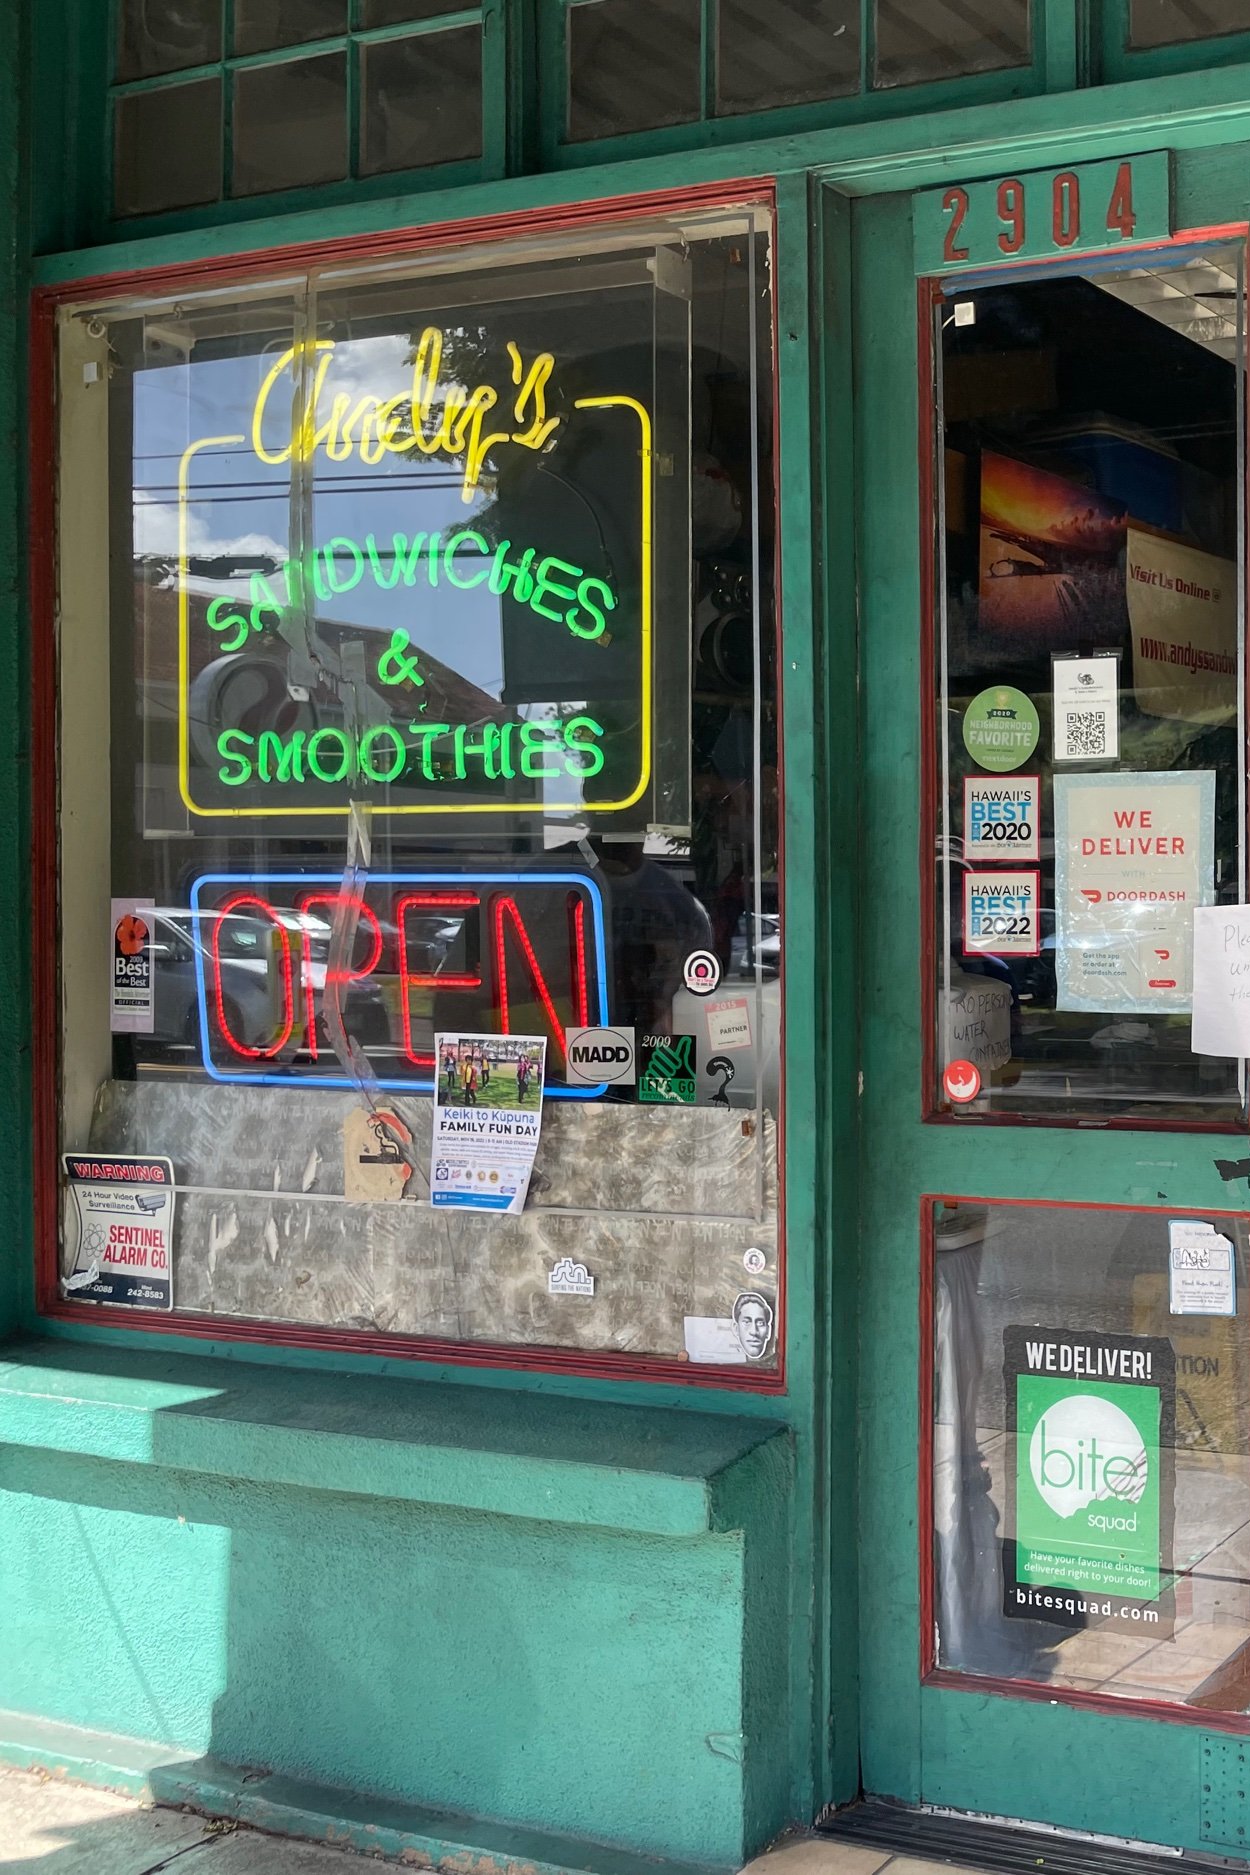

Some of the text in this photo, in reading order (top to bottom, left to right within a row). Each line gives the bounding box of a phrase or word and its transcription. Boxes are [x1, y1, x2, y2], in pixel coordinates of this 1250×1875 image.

[942, 162, 1136, 264] 2904
[252, 327, 561, 503] Andy's
[205, 529, 618, 652] SANDWICHES
[1129, 563, 1210, 601] Visit Us Online
[377, 628, 424, 687] &
[970, 720, 1033, 731] NEIGHBORHOOD
[969, 731, 1032, 747] FAVORITE
[217, 716, 605, 787] SMOOTHIES
[971, 791, 1032, 802] HAWAII'S
[971, 802, 1032, 822] BEST
[1114, 811, 1152, 829] WE
[982, 822, 1032, 841] 2020
[1081, 837, 1185, 856] DELIVER
[1122, 870, 1146, 878] WITH
[971, 885, 1031, 896] HAWAII'S
[1107, 891, 1185, 903] DOORDASH
[971, 897, 1031, 916] BEST
[982, 917, 1031, 935] 2022
[115, 957, 149, 976] Best
[130, 977, 146, 987] Best
[212, 890, 589, 1064] OPEN
[715, 1001, 737, 1011] 2015
[719, 1025, 748, 1035] PARTNER
[953, 1020, 989, 1041] WATER
[642, 1035, 671, 1048] 2009
[572, 1046, 630, 1063] MADD
[641, 1078, 695, 1094] LET'S GO
[444, 1108, 473, 1120] Keiki
[476, 1110, 488, 1121] to
[440, 1121, 538, 1136] FAMILY FUN DAY
[74, 1163, 165, 1182] WARNING
[89, 1200, 135, 1210] Surveillance
[94, 1191, 111, 1199] Hour
[114, 1193, 134, 1201] Video
[110, 1224, 165, 1248] SENTINEL
[103, 1244, 168, 1269] ALARM CO.
[127, 1288, 164, 1300] 242-8583
[1040, 1418, 1138, 1497] bite
[1087, 1511, 1138, 1533] squad
[1030, 1551, 1145, 1574] Have your favorite dishes
[1024, 1563, 1151, 1588] delivered right to your door!
[1016, 1589, 1159, 1623] bitesquad.com
